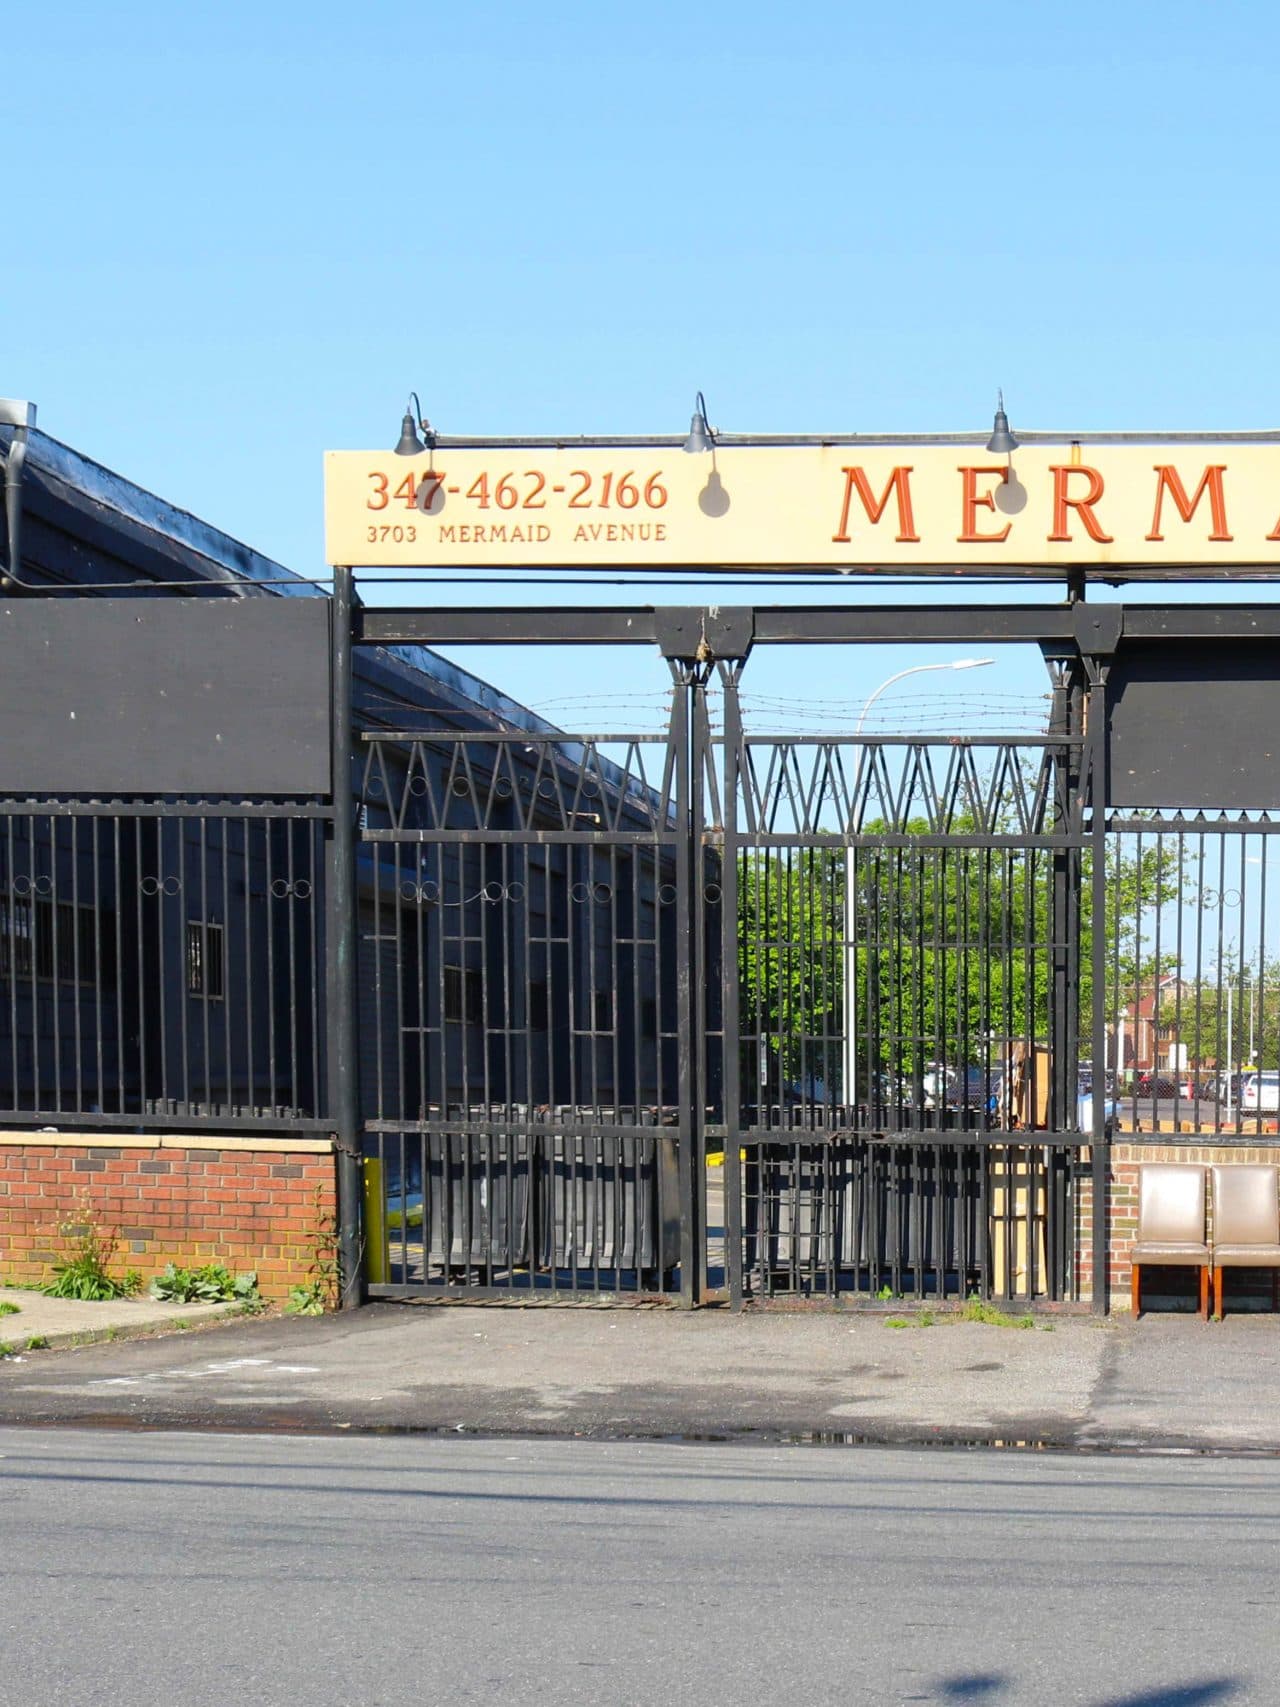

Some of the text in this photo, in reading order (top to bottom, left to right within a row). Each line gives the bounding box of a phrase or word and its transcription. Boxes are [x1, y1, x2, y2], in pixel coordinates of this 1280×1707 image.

[367, 471, 668, 511] 347-462-2166
[367, 524, 666, 543] 3703 MERMAID AVENUE
